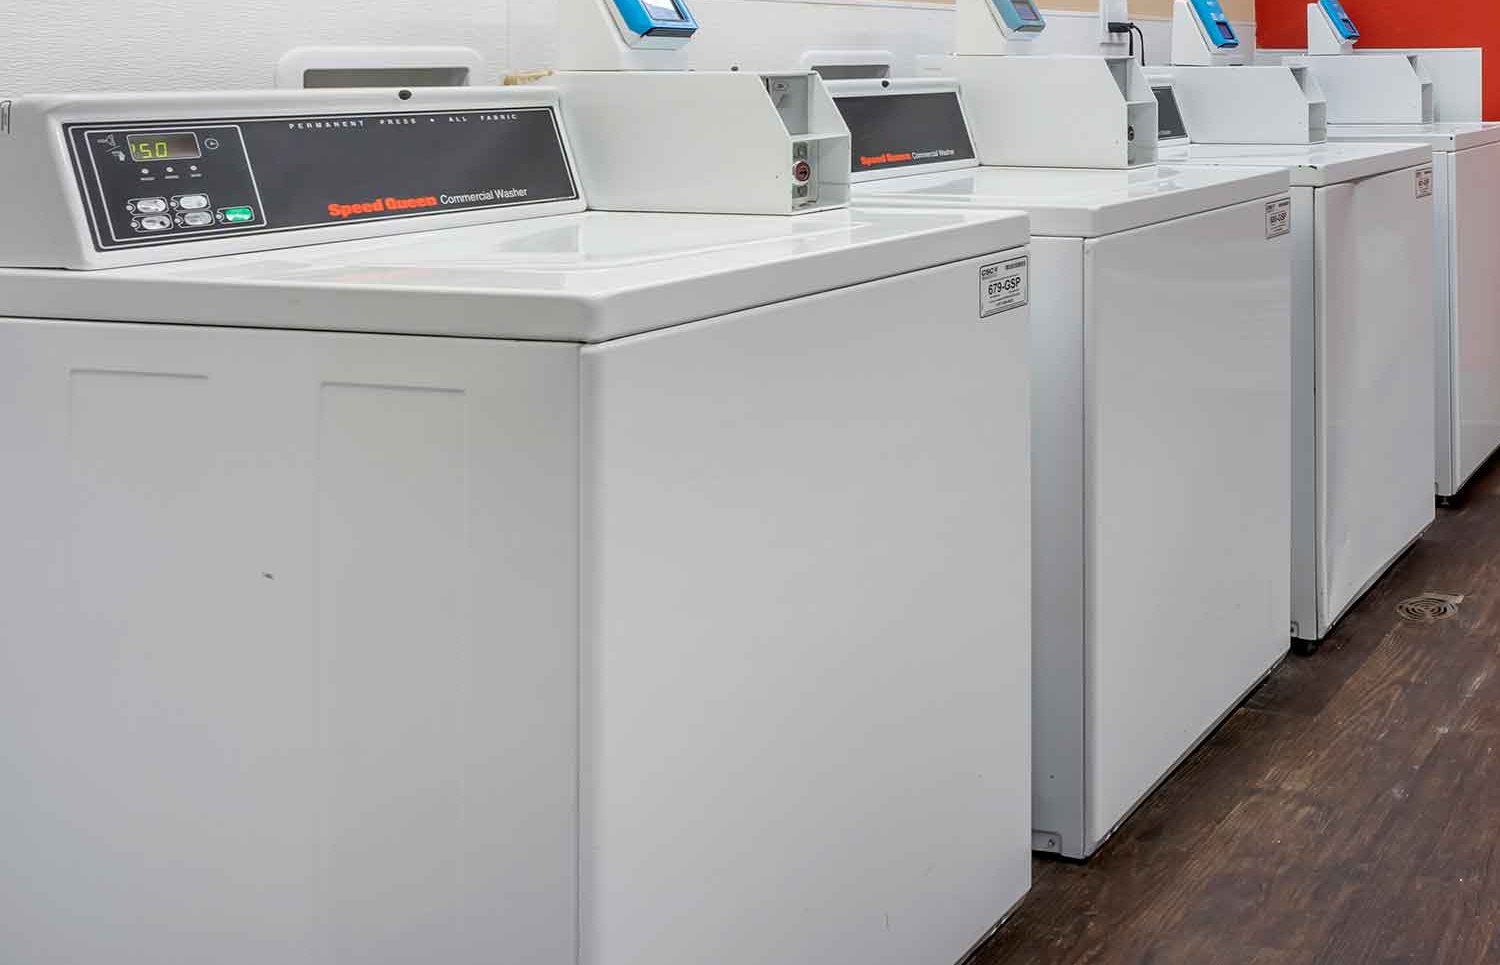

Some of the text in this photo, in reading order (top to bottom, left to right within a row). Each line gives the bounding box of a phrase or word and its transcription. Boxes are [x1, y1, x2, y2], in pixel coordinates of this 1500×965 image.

[288, 120, 365, 130] PERMANENT
[327, 188, 528, 218] Speed Queen Commercial Washer
[988, 276, 1021, 295] 679-GSP
